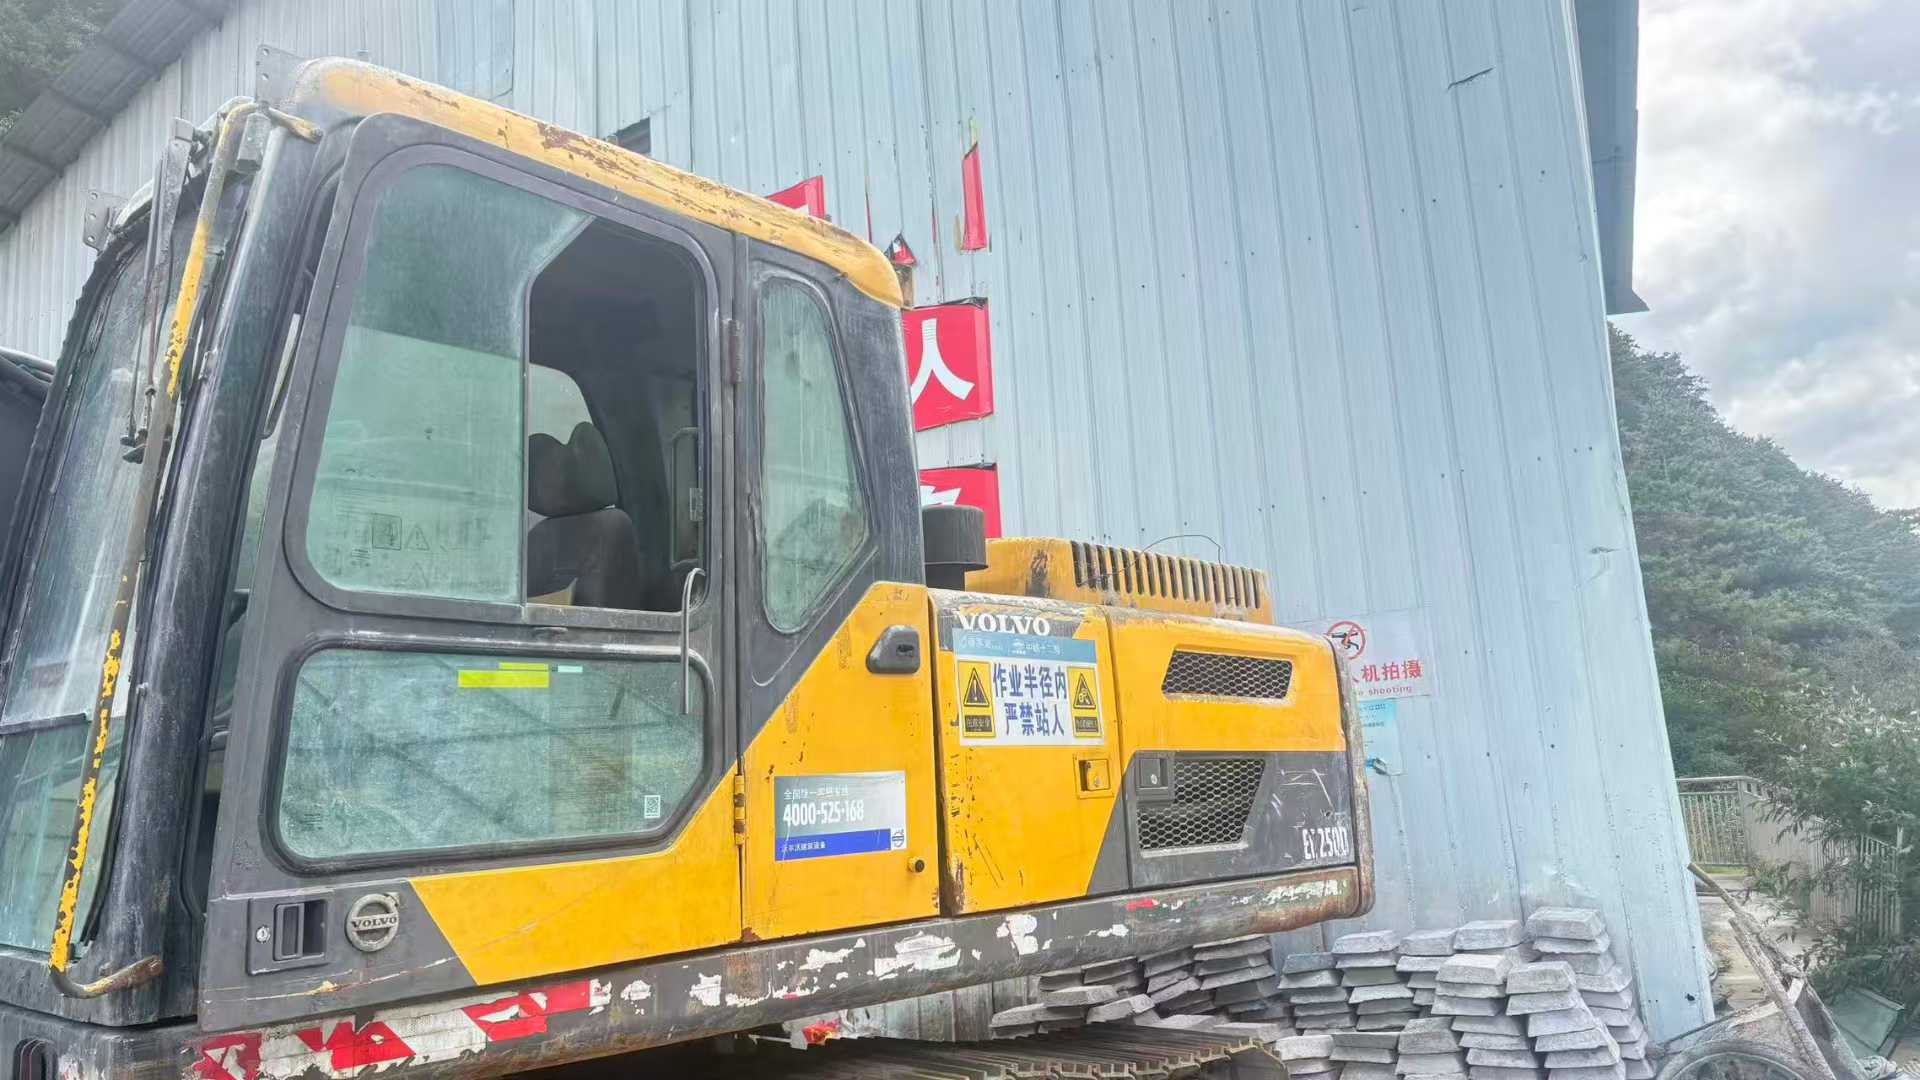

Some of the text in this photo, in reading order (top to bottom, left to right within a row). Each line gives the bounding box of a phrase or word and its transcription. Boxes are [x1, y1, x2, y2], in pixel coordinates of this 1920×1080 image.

[957, 613, 1050, 636] VOLVO
[993, 663, 1067, 699] 作业半径内
[1352, 659, 1423, 684] 机拍摄
[1003, 702, 1065, 737] 严禁站人
[783, 799, 864, 826] 4000-525-168
[351, 916, 397, 928] VOLVO
